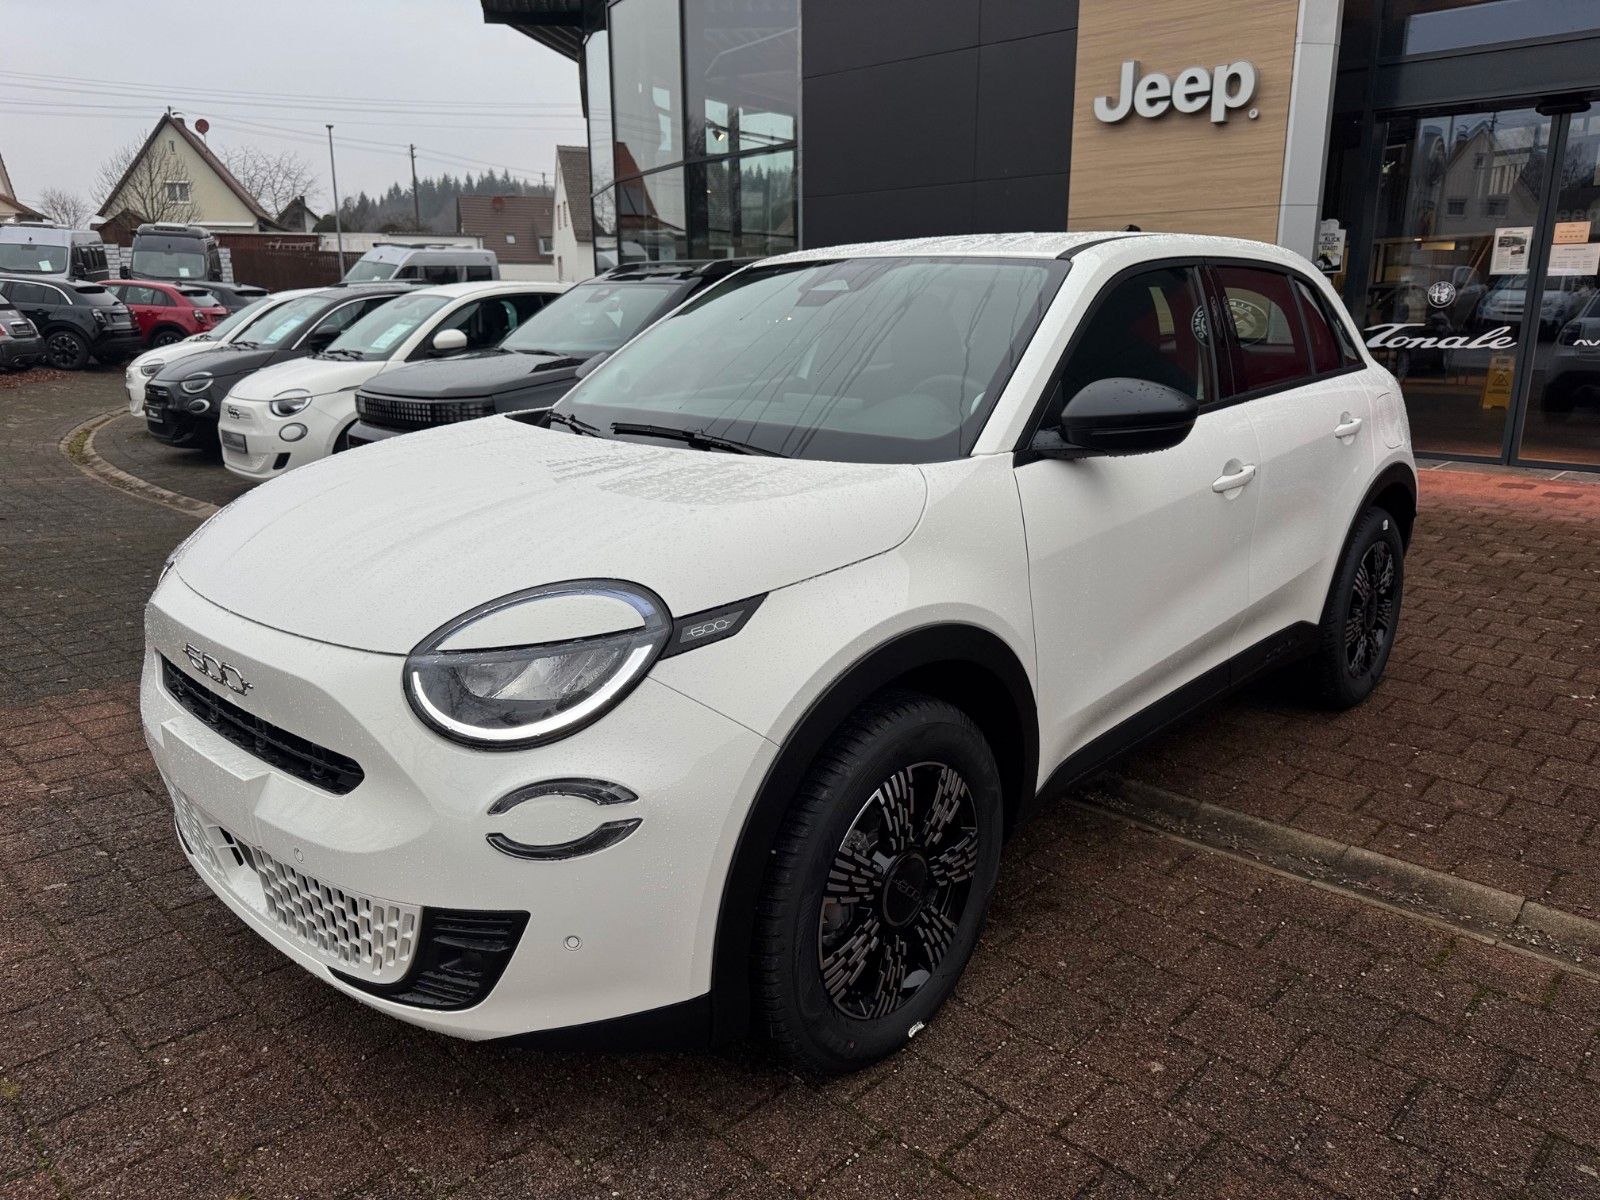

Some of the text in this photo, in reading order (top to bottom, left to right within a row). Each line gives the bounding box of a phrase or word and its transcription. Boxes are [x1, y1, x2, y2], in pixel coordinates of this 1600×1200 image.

[1093, 60, 1258, 123] Jeep
[1364, 323, 1517, 349] Tonale
[687, 620, 730, 637] 600
[182, 643, 253, 696] 600
